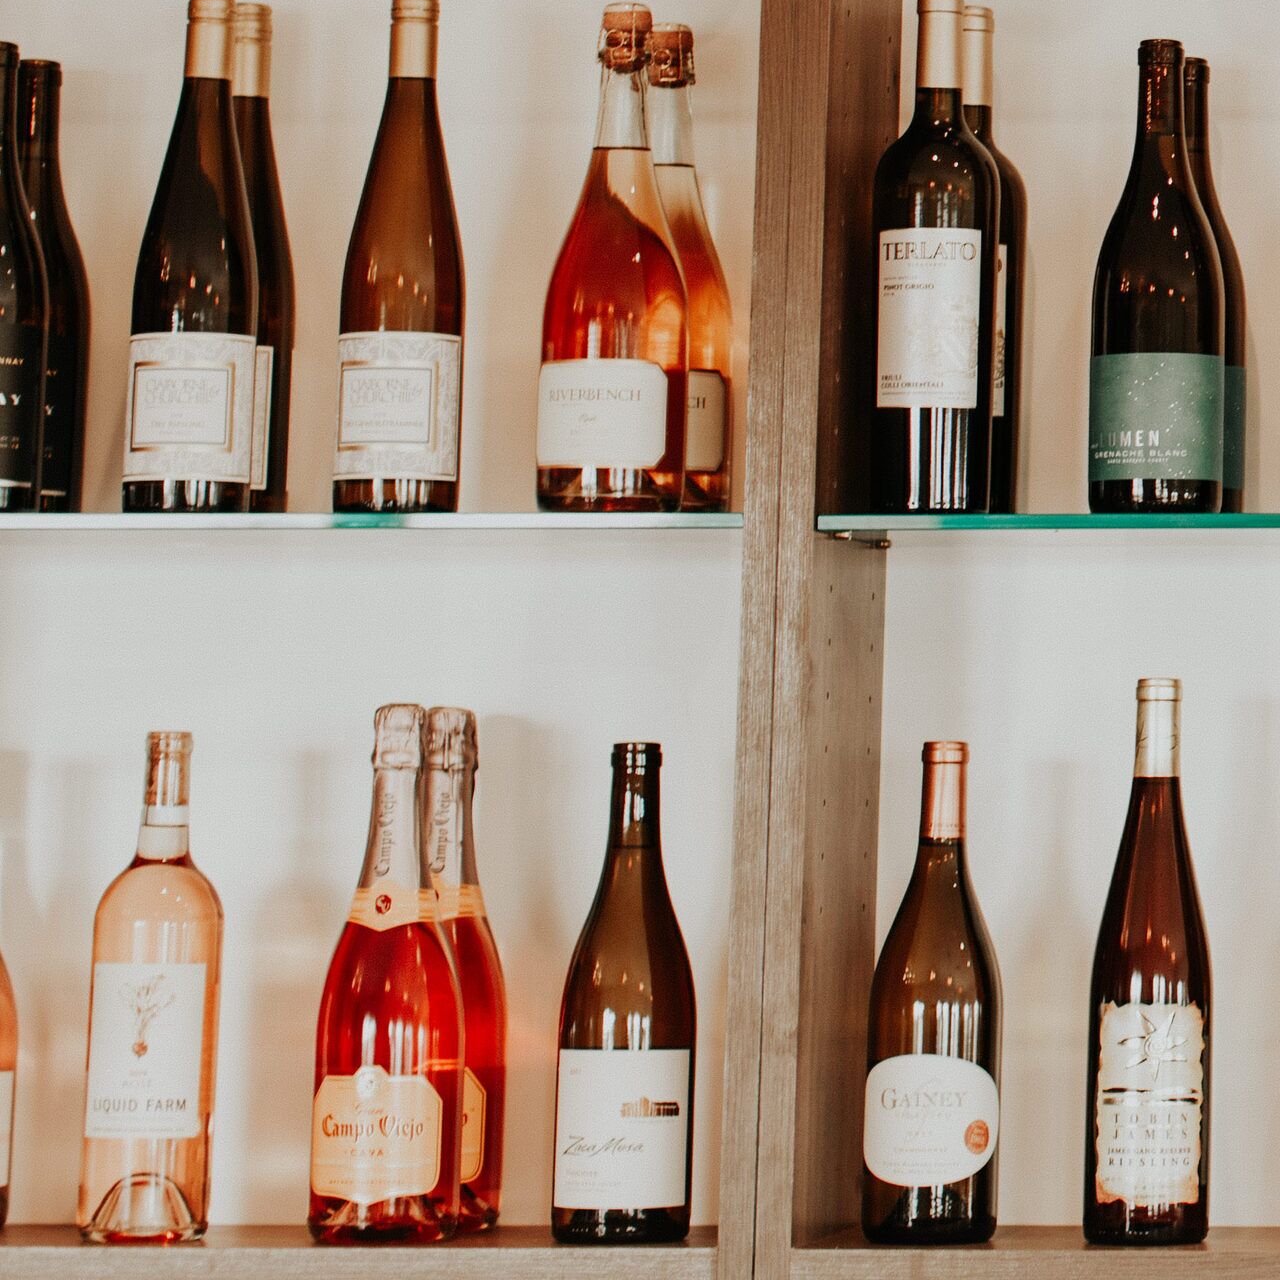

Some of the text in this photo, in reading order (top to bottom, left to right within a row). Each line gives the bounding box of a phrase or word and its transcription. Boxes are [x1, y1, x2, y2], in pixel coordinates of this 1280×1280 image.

[882, 242, 977, 262] TERLATO
[549, 388, 642, 402] RIVERBENCH
[1149, 449, 1189, 458] BLANC
[374, 792, 398, 878] Campo Viejo
[429, 791, 454, 874] Campo Viejo
[93, 1098, 187, 1113] LIQUID FARM
[880, 1087, 970, 1111] GAINEY
[322, 1112, 424, 1143] Campo Viejo
[1113, 1113, 1189, 1125] TOBIN
[1113, 1129, 1189, 1140] JAMES
[561, 1135, 598, 1157] Zaca
[1108, 1157, 1190, 1166] RIESLING
